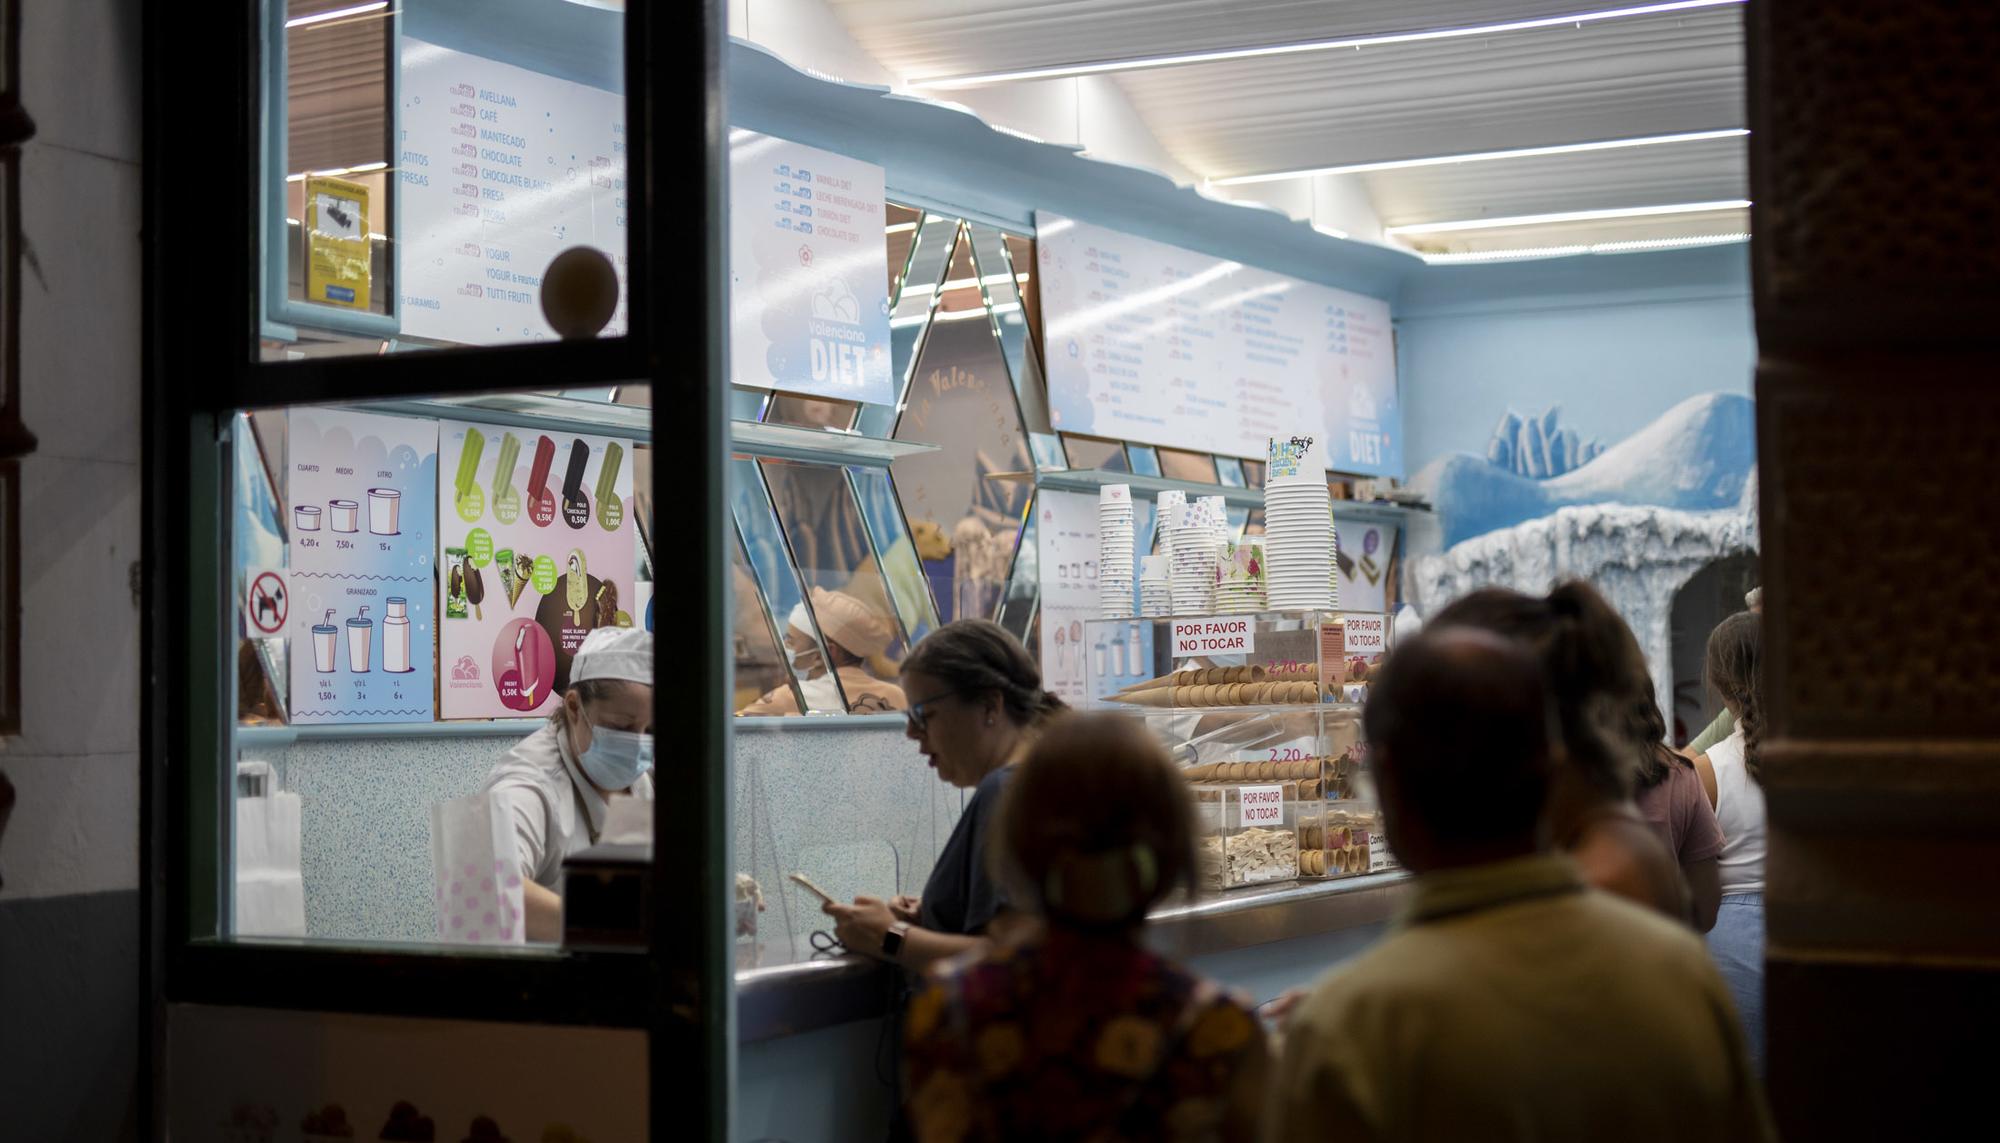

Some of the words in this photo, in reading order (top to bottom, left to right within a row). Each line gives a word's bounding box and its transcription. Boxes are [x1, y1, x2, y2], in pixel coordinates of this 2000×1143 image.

[479, 88, 517, 108] AVELLANA
[479, 108, 498, 123] CAFÉ
[480, 129, 526, 149] MANTECADO
[481, 148, 522, 167] CHOCOLATE
[481, 168, 523, 187] CHOCOLATE
[524, 176, 552, 193] BLANCO
[482, 187, 505, 201] FRESA
[485, 247, 511, 262] YOGUR
[487, 267, 510, 282] YOGUR
[486, 287, 507, 300] TUTTI
[507, 290, 532, 305] FRUTTI
[808, 319, 866, 343] Valenciana
[808, 338, 867, 387] DIET
[1350, 431, 1381, 465] DIET
[297, 464, 320, 473] CUARTO
[335, 467, 354, 475] MEDIO
[536, 513, 552, 521] 0,50€
[571, 515, 587, 524] 0,50€
[345, 588, 378, 596] GRANIZADO
[1176, 623, 1202, 636] POR
[1205, 621, 1247, 635] FAVOR
[1347, 619, 1360, 631] POR
[1361, 619, 1381, 631] FAVOR
[1179, 639, 1198, 651] NO
[1201, 637, 1244, 650] TOCAR
[1349, 635, 1358, 646] NO
[1359, 635, 1381, 646] TOCAR
[1268, 659, 1297, 676] 2,70
[502, 689, 517, 697] 0,50€
[1243, 793, 1258, 804] POR
[1258, 791, 1280, 803] FAVOR
[1245, 809, 1256, 820] NO
[1256, 807, 1278, 819] TOCAR
